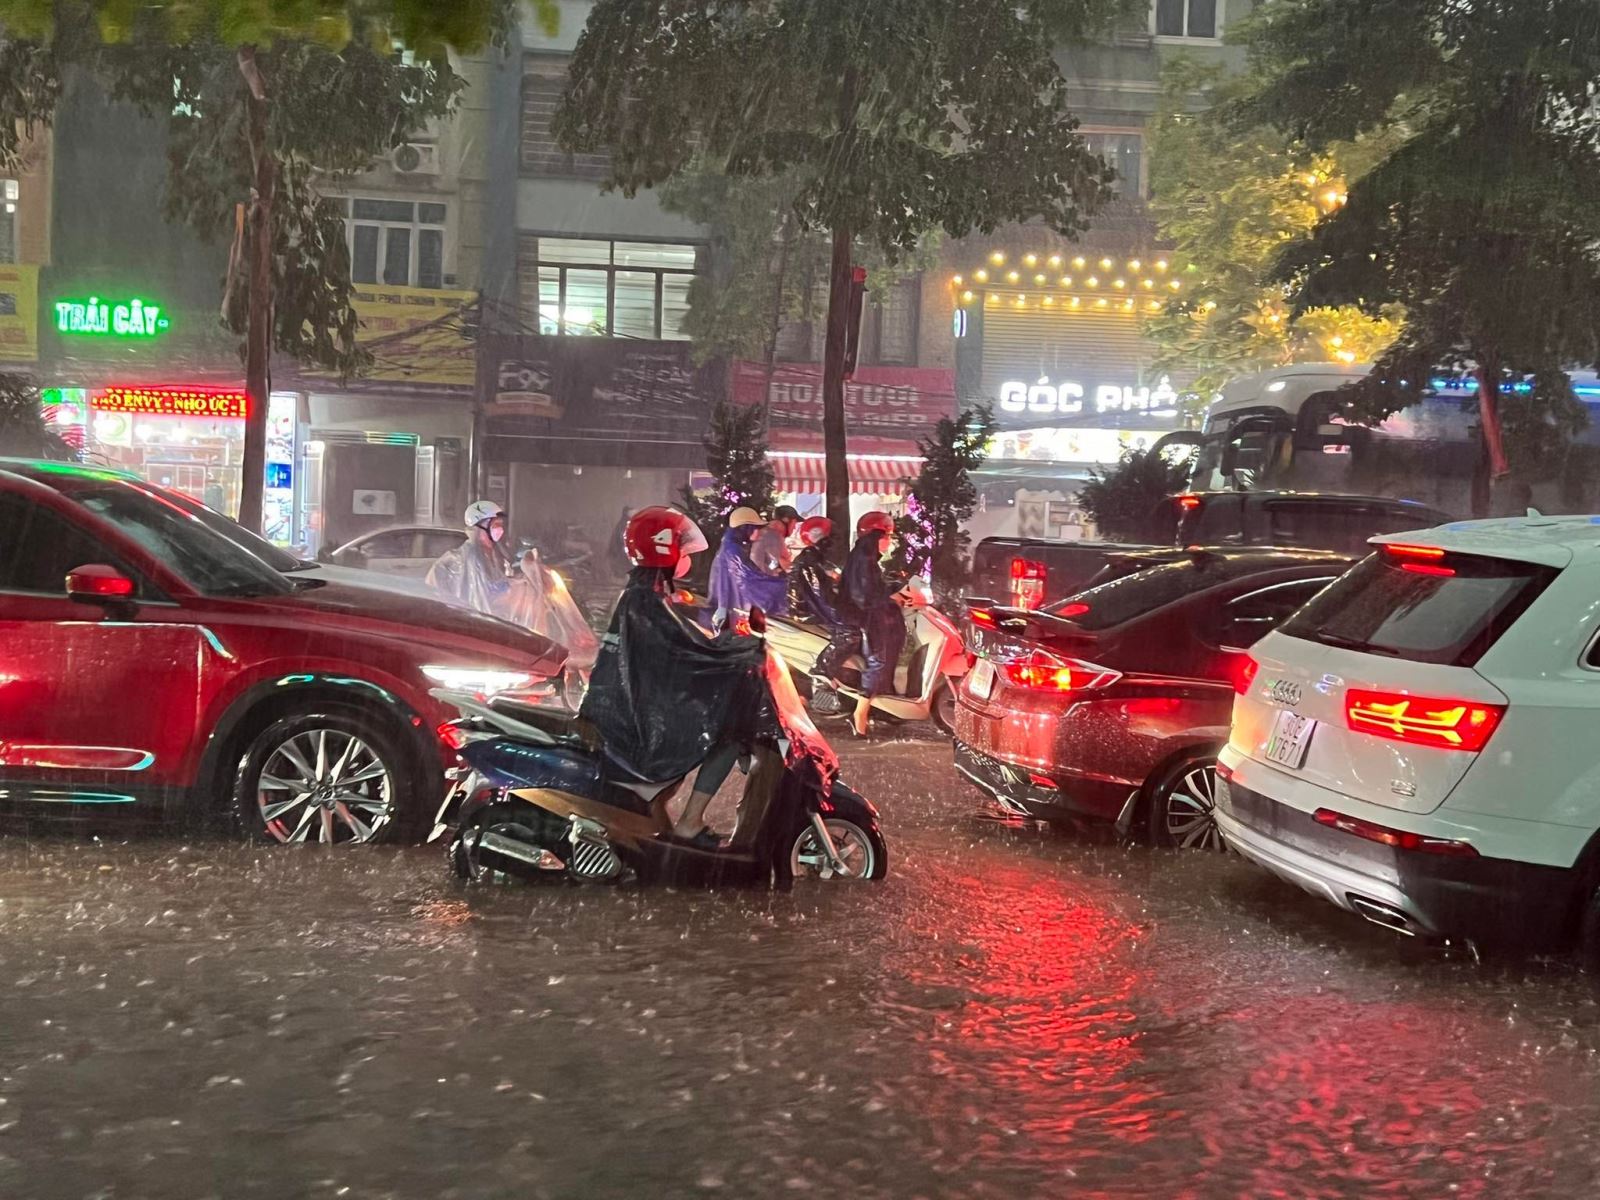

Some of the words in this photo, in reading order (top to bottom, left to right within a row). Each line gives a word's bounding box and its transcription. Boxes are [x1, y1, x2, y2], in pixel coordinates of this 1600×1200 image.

[123, 394, 162, 412] ENVY
[770, 382, 824, 404] HO
[1000, 375, 1083, 412] GÓC
